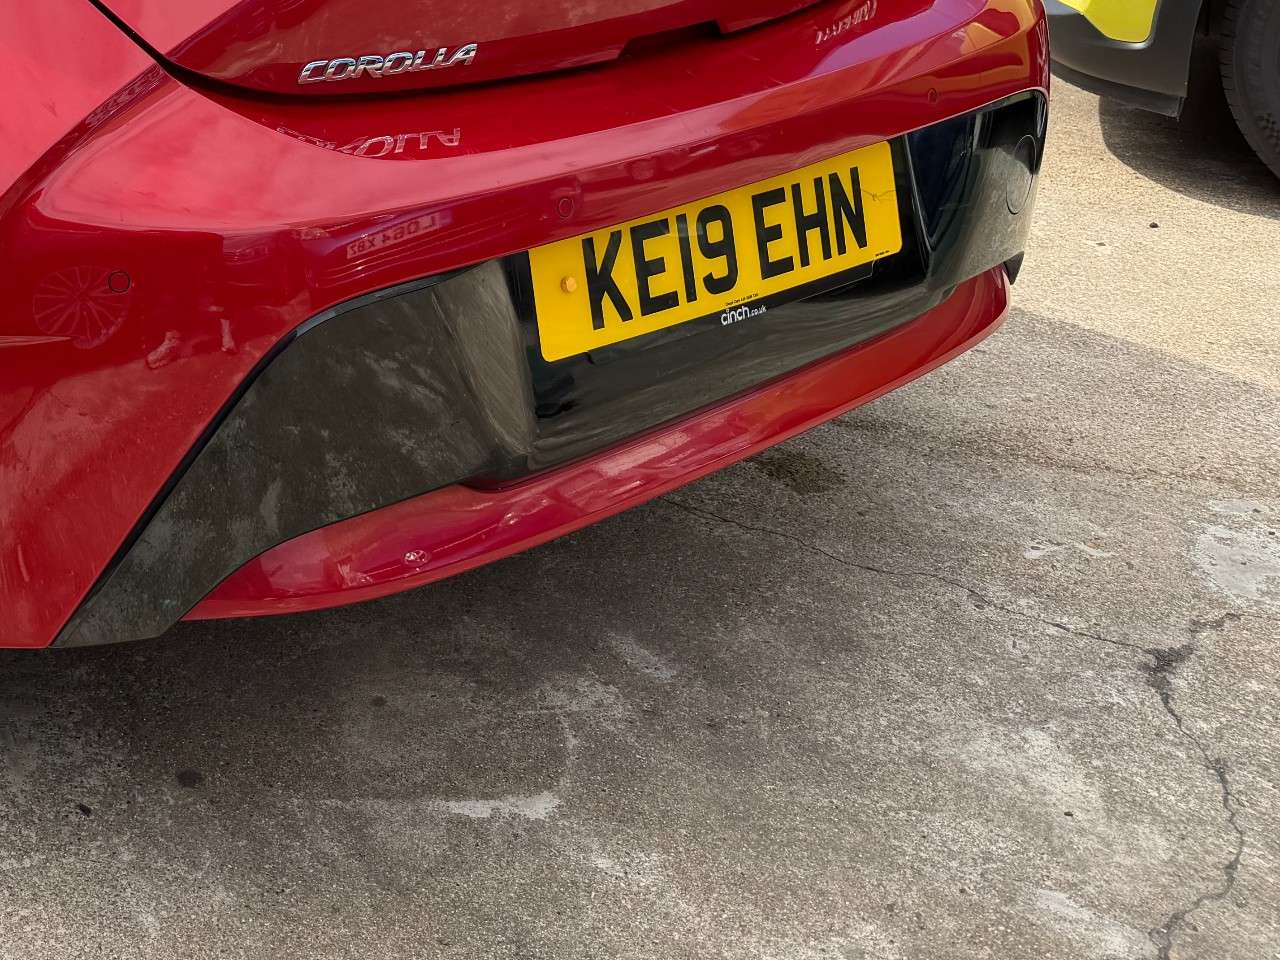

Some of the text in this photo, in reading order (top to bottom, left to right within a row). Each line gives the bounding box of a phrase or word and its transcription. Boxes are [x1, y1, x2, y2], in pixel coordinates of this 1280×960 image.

[298, 43, 478, 84] COROLLA
[582, 167, 868, 331] KE19 EHN
